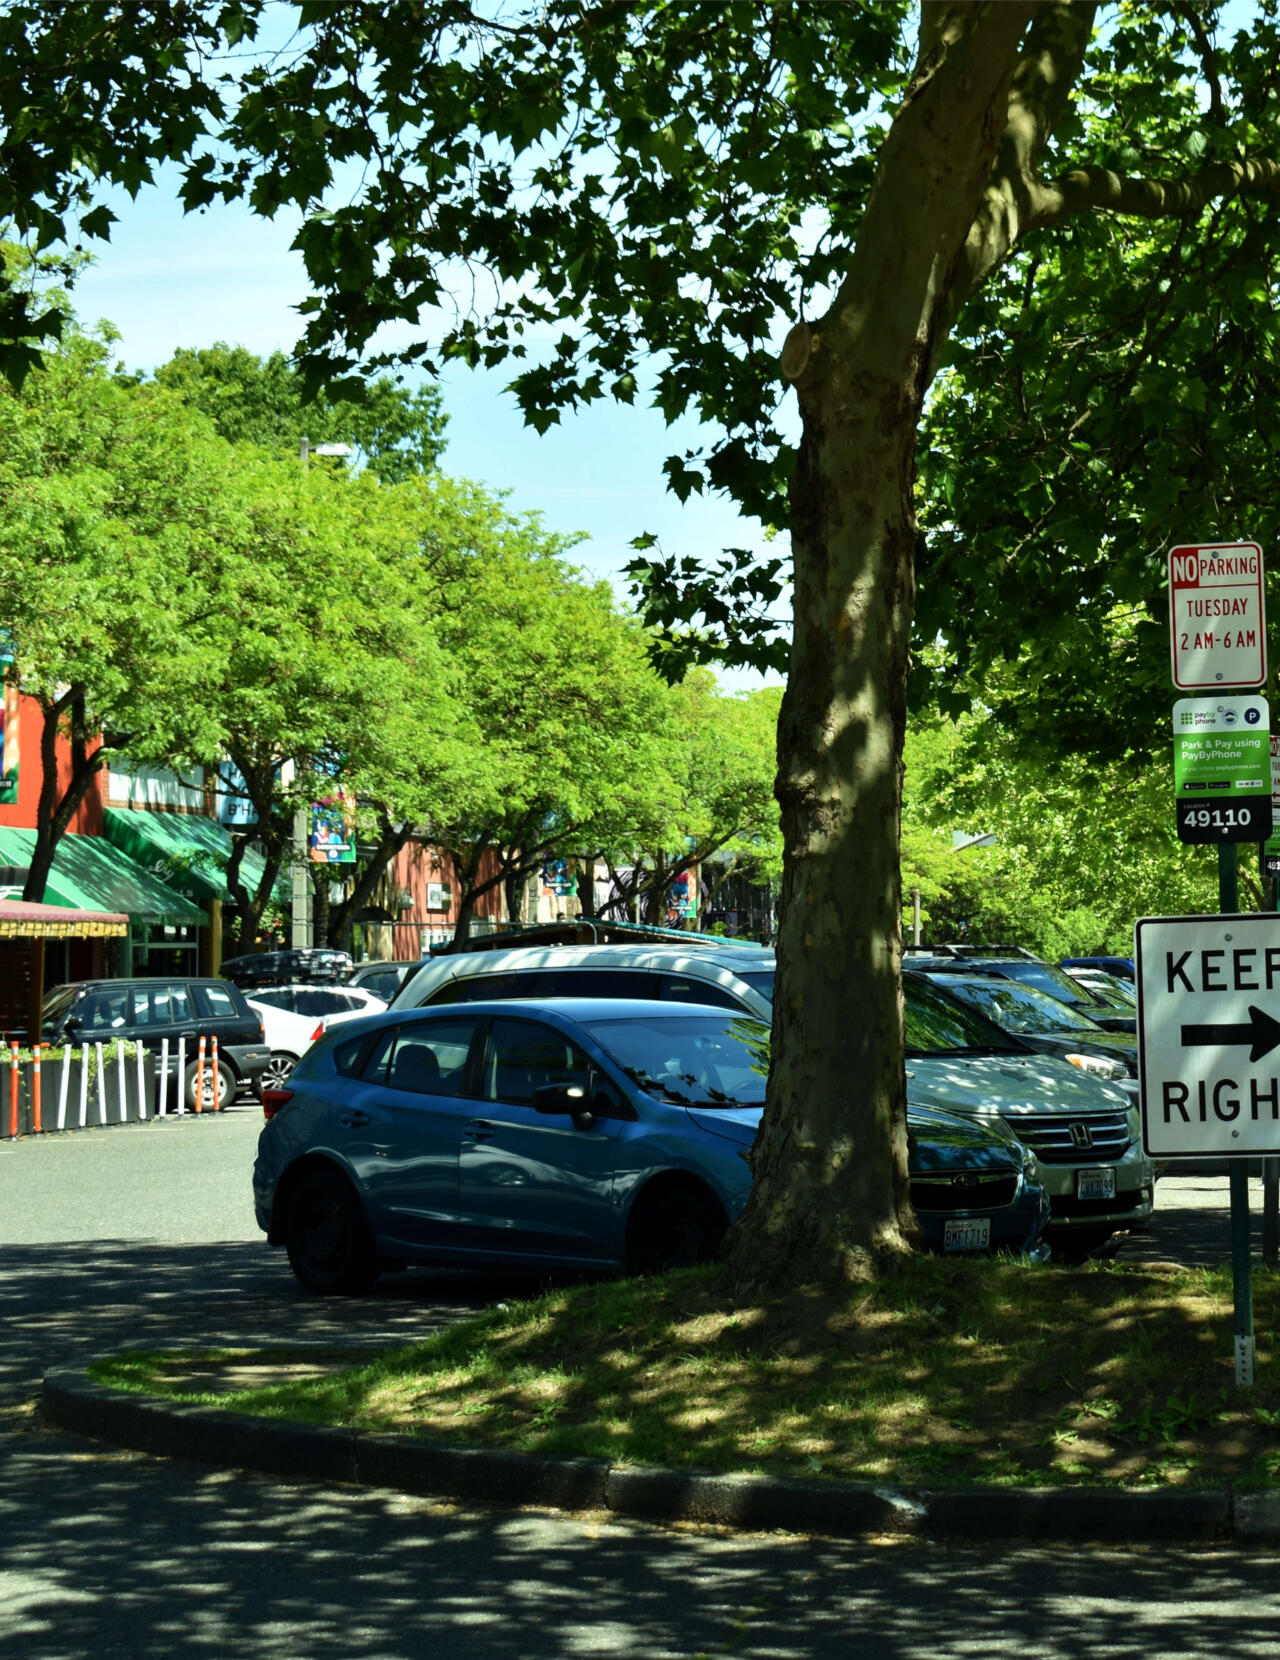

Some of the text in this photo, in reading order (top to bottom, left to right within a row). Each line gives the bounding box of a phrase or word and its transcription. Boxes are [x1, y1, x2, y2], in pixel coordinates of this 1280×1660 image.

[1172, 555, 1257, 583] NO PARKING
[1187, 598, 1248, 618] TUESDAY
[1181, 633, 1189, 650] 2
[1236, 630, 1256, 648] AM
[1181, 738, 1261, 750] Park & Pay using
[1182, 750, 1242, 761] PayByPhone
[1184, 808, 1251, 828] 49110
